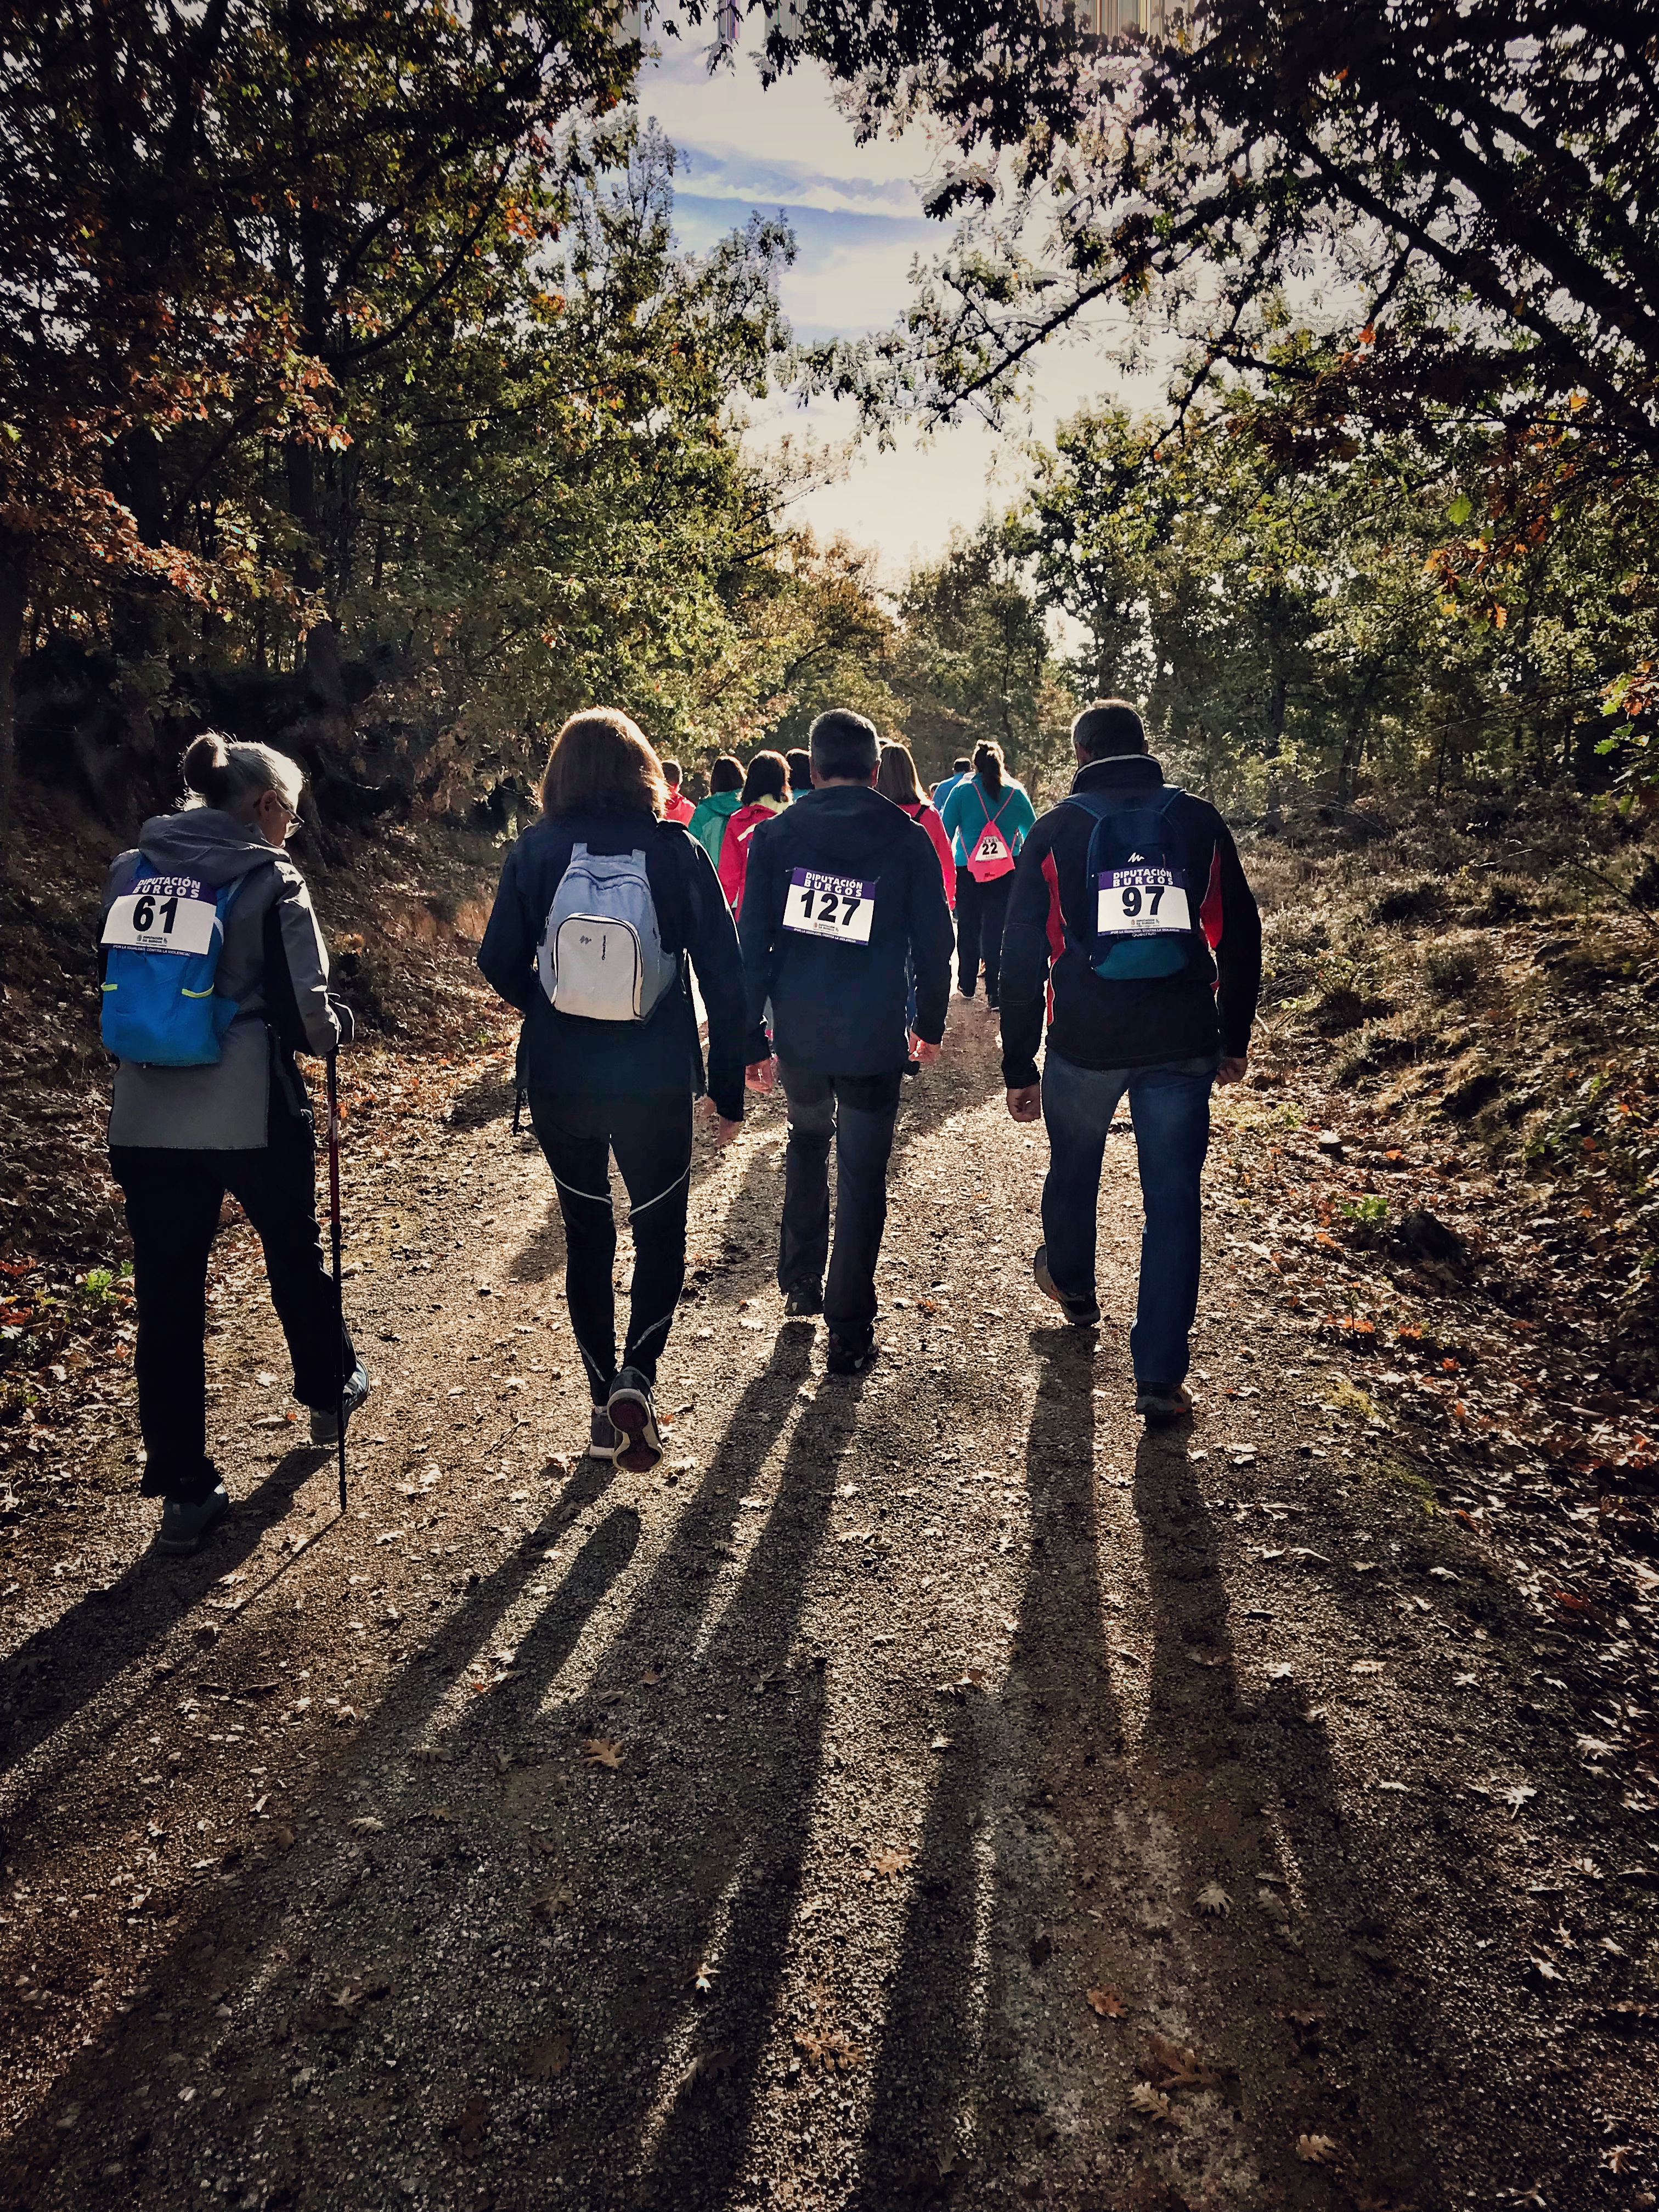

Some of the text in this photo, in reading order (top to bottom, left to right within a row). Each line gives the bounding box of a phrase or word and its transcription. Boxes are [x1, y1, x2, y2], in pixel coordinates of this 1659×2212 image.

[982, 843, 998, 855] 22
[806, 872, 863, 889] DIPUTACIÓN
[1113, 867, 1172, 880] DIPUTACIÓN
[1113, 874, 1173, 888] BURGOS
[137, 877, 201, 889] DIPUTACIÓN
[804, 879, 862, 897] BURGOS
[132, 884, 200, 899] BURGOS
[801, 889, 861, 926] 127
[1122, 886, 1164, 917] 97
[133, 895, 178, 934] 61
